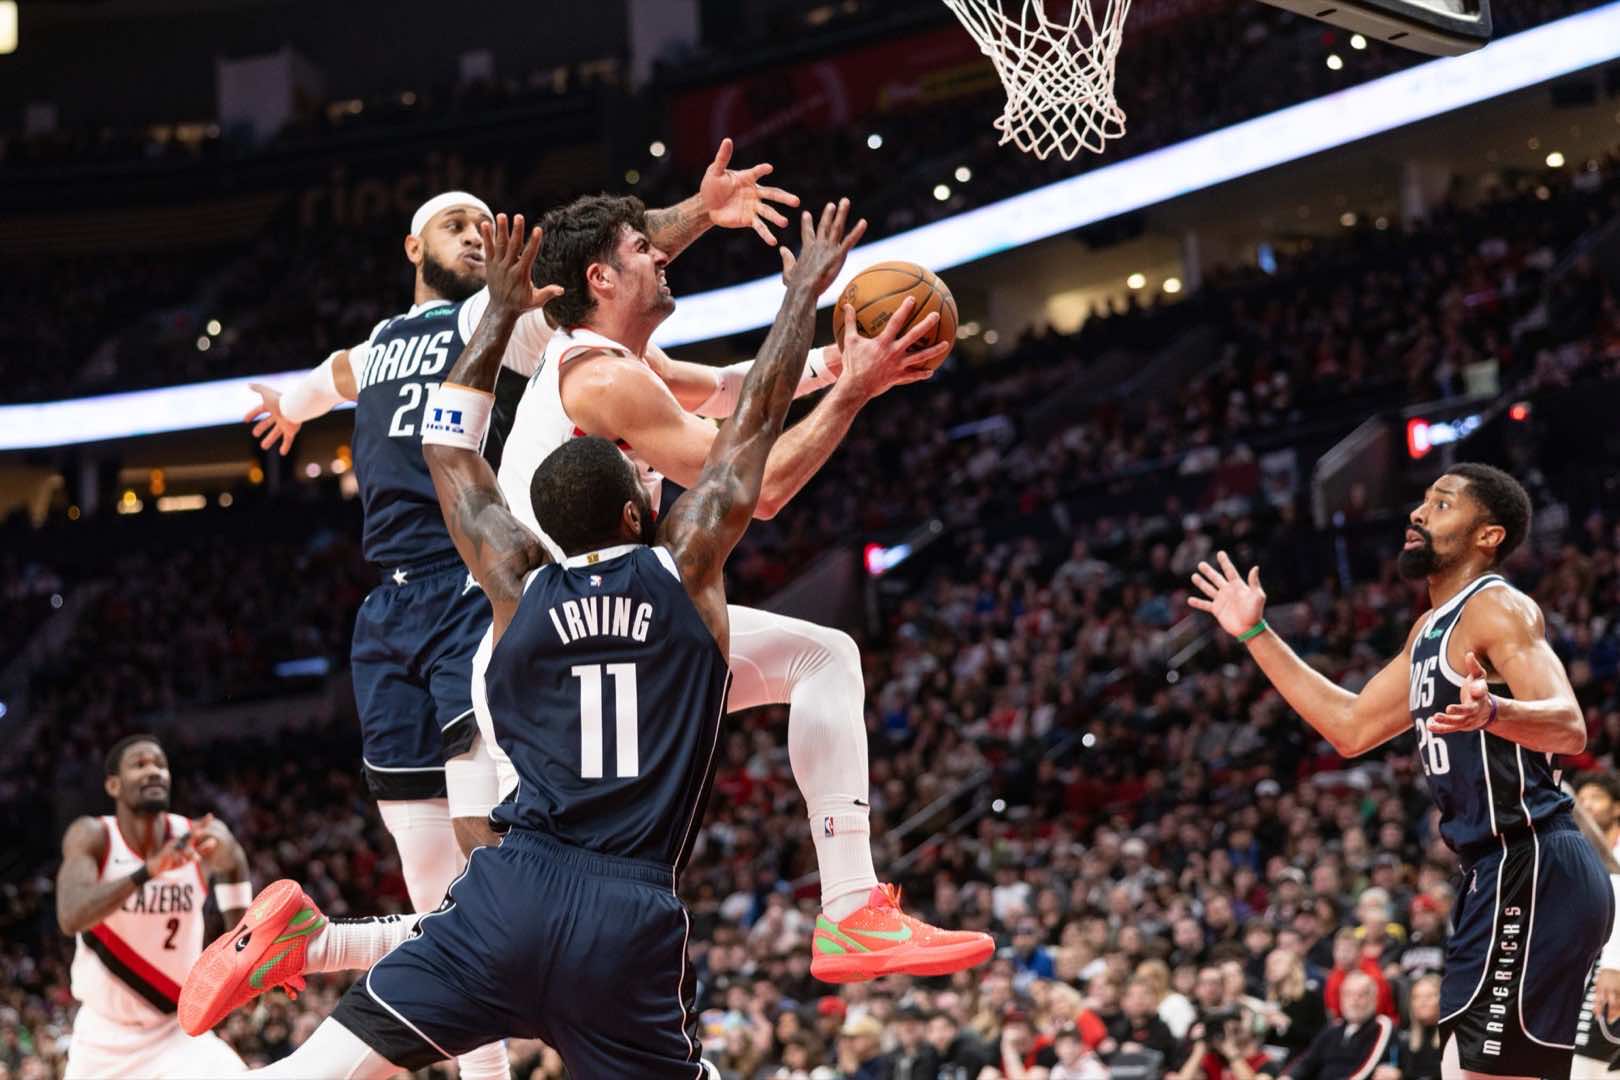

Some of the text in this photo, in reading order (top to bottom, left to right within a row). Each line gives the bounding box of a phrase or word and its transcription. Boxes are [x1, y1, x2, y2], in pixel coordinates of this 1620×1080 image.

[361, 330, 454, 390] MAVS
[432, 407, 463, 425] 11
[548, 595, 653, 646] IRVING
[571, 662, 639, 779] 11
[163, 917, 180, 949] 2
[1482, 906, 1521, 1056] MAVERICKS
